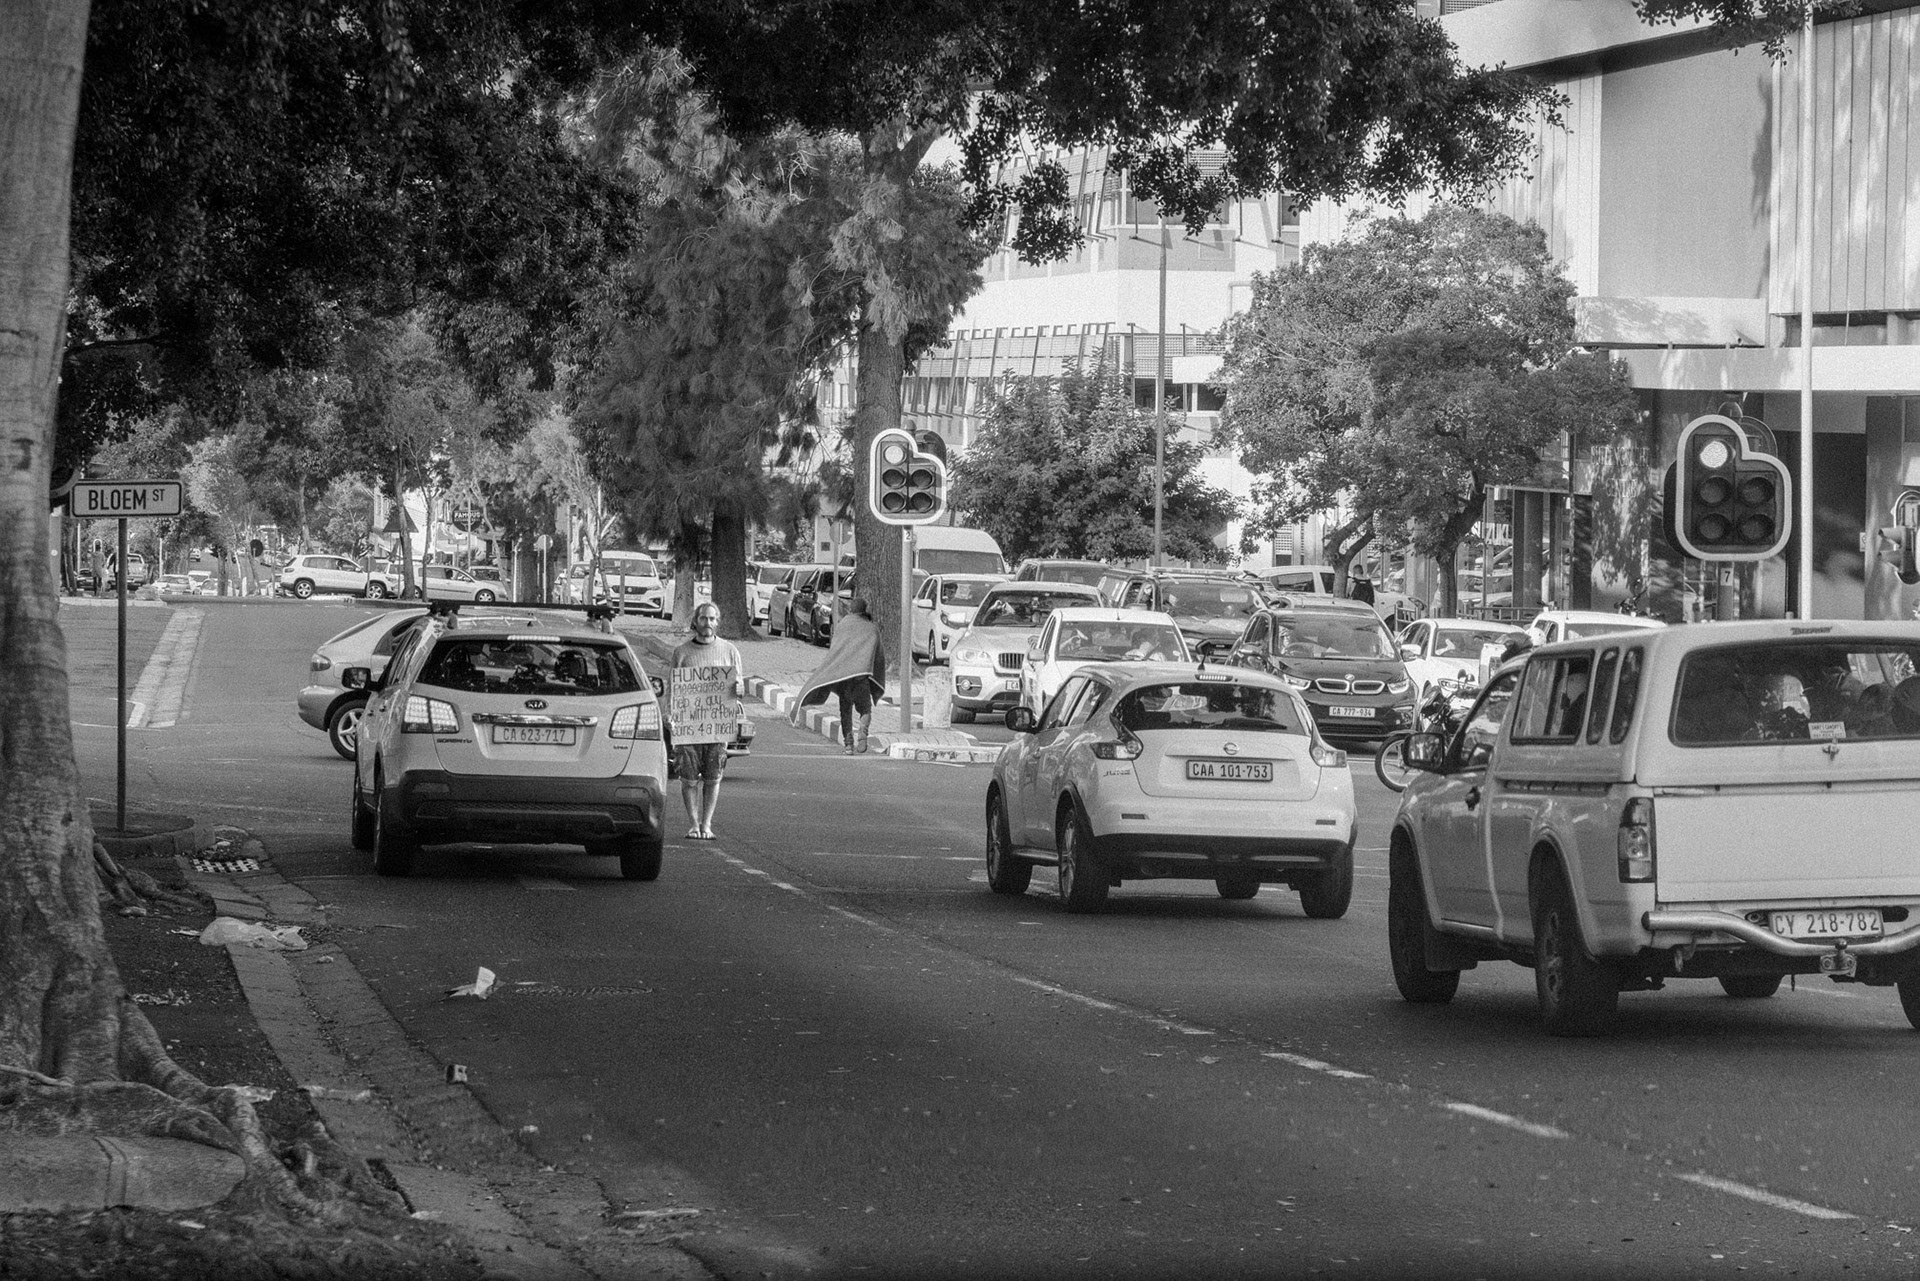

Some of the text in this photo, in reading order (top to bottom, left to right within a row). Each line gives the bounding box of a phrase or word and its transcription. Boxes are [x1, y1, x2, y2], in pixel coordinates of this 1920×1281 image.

[88, 488, 165, 510] BLOEM ST
[1724, 570, 1731, 583] 7
[672, 666, 732, 683] HUNGRY
[1332, 707, 1372, 717] CA 777-934
[503, 727, 566, 743] CA 623-717
[697, 722, 705, 736] 4
[706, 723, 713, 735] a
[1192, 762, 1268, 779] CAA 101-753
[1774, 911, 1880, 935] CY 218-782
